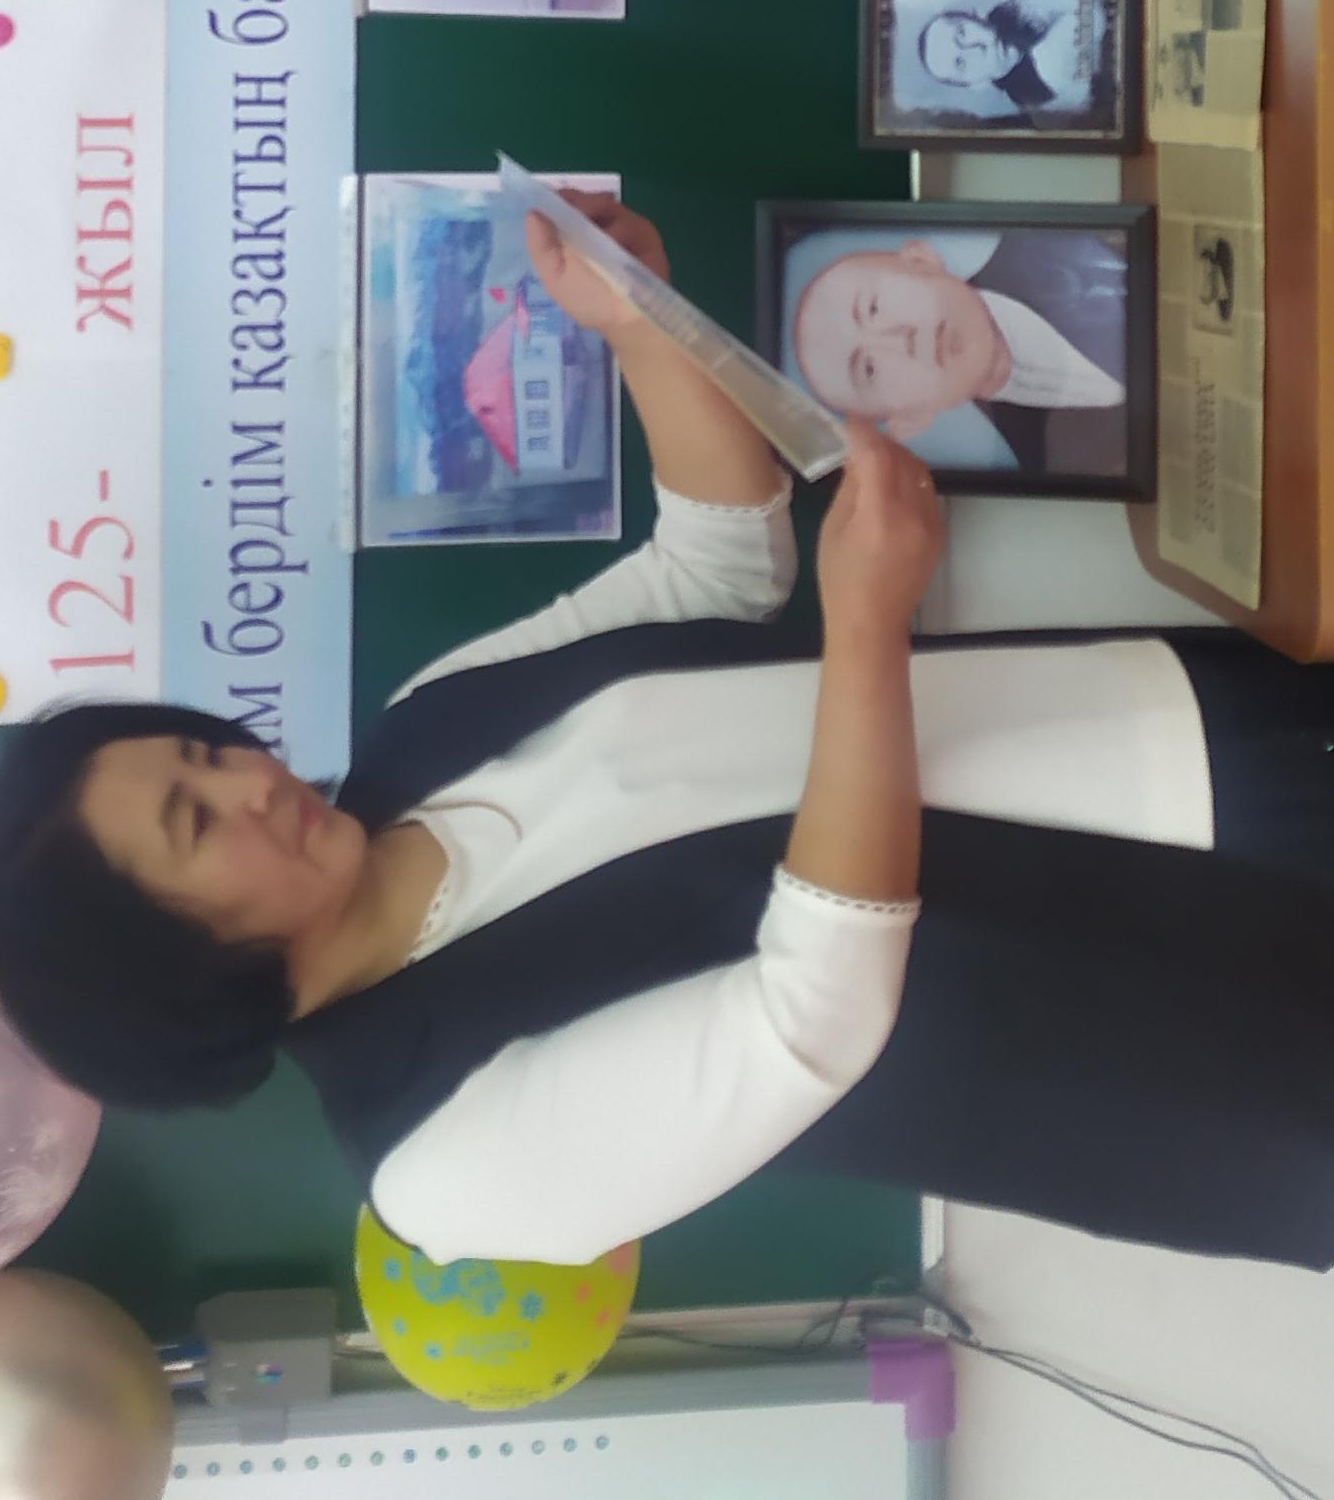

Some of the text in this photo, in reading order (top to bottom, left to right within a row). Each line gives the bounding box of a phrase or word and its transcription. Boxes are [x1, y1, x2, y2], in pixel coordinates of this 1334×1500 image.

[47, 112, 135, 674] 125- жыл
[223, 72, 297, 394] қазақтың
[201, 421, 309, 657] бердім
